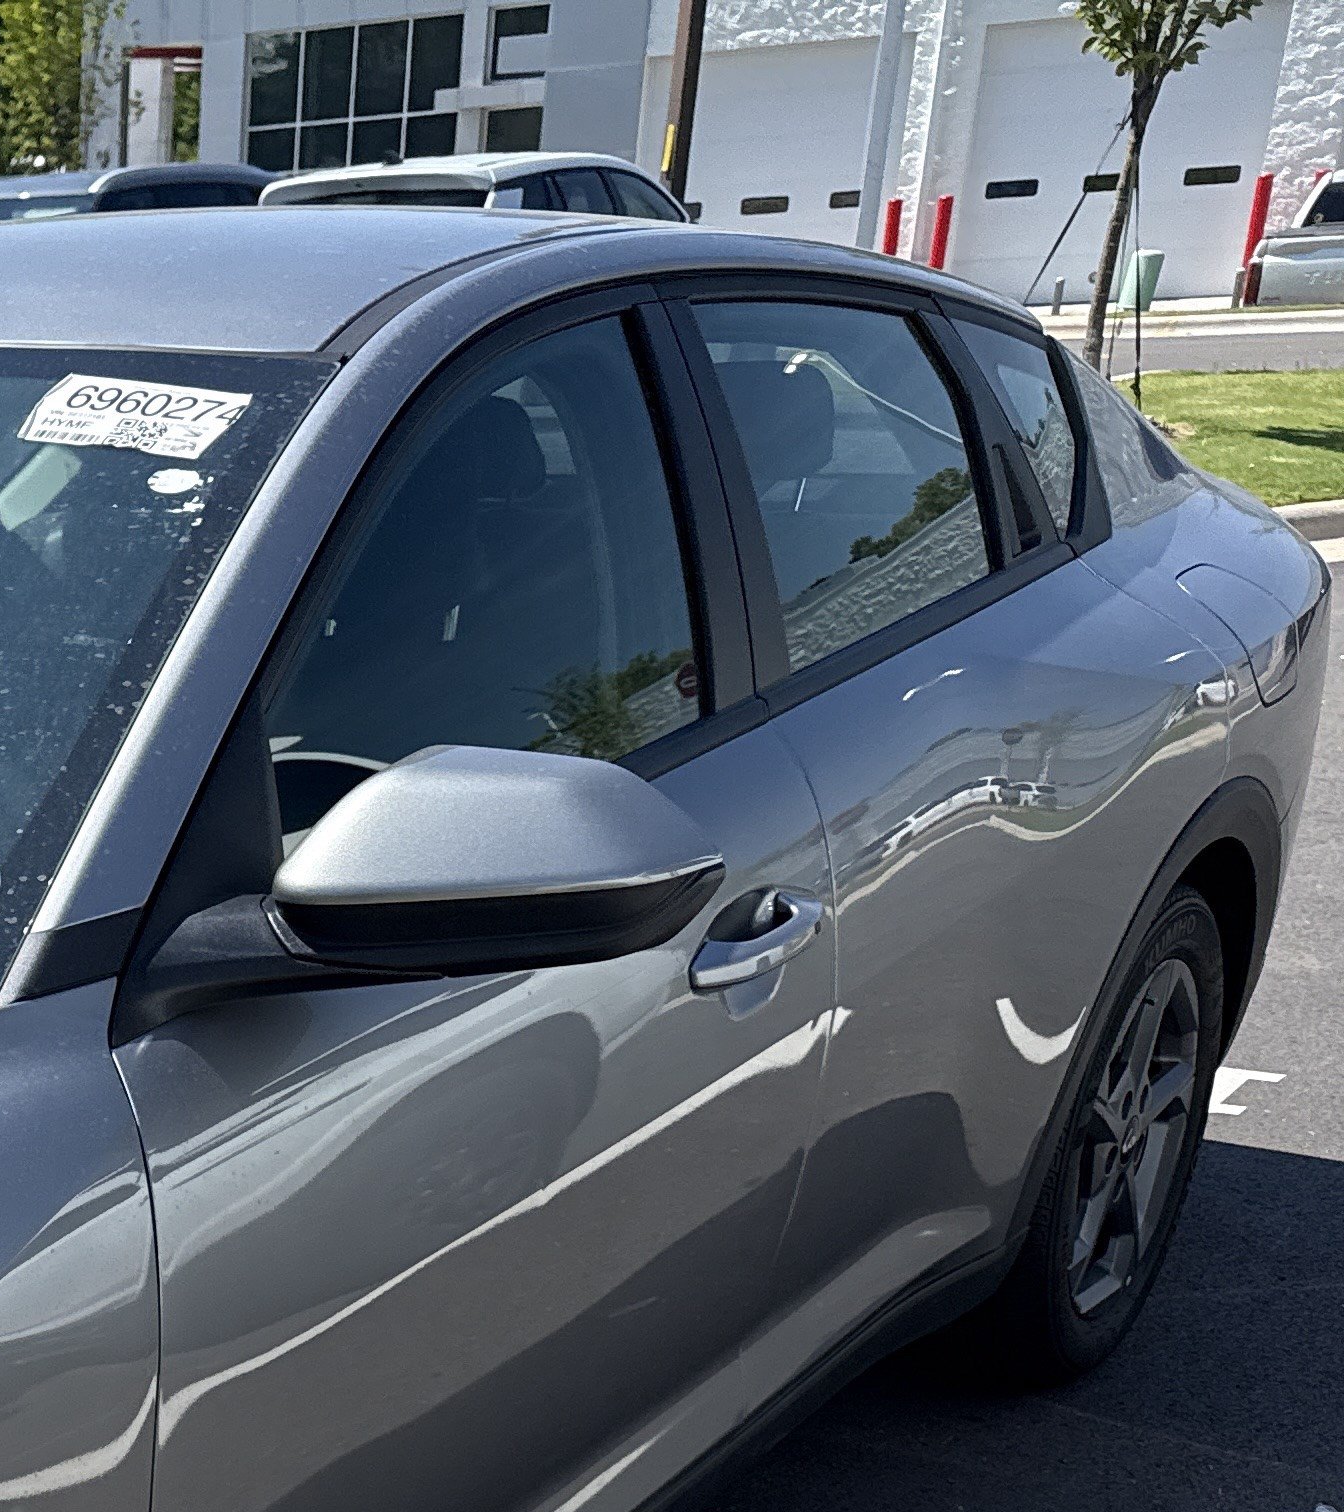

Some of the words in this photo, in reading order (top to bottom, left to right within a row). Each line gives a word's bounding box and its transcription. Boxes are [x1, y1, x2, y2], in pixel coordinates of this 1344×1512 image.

[41, 417, 94, 429] HYMF
[66, 385, 248, 426] 6960274
[1144, 913, 1197, 976] KUMHO
